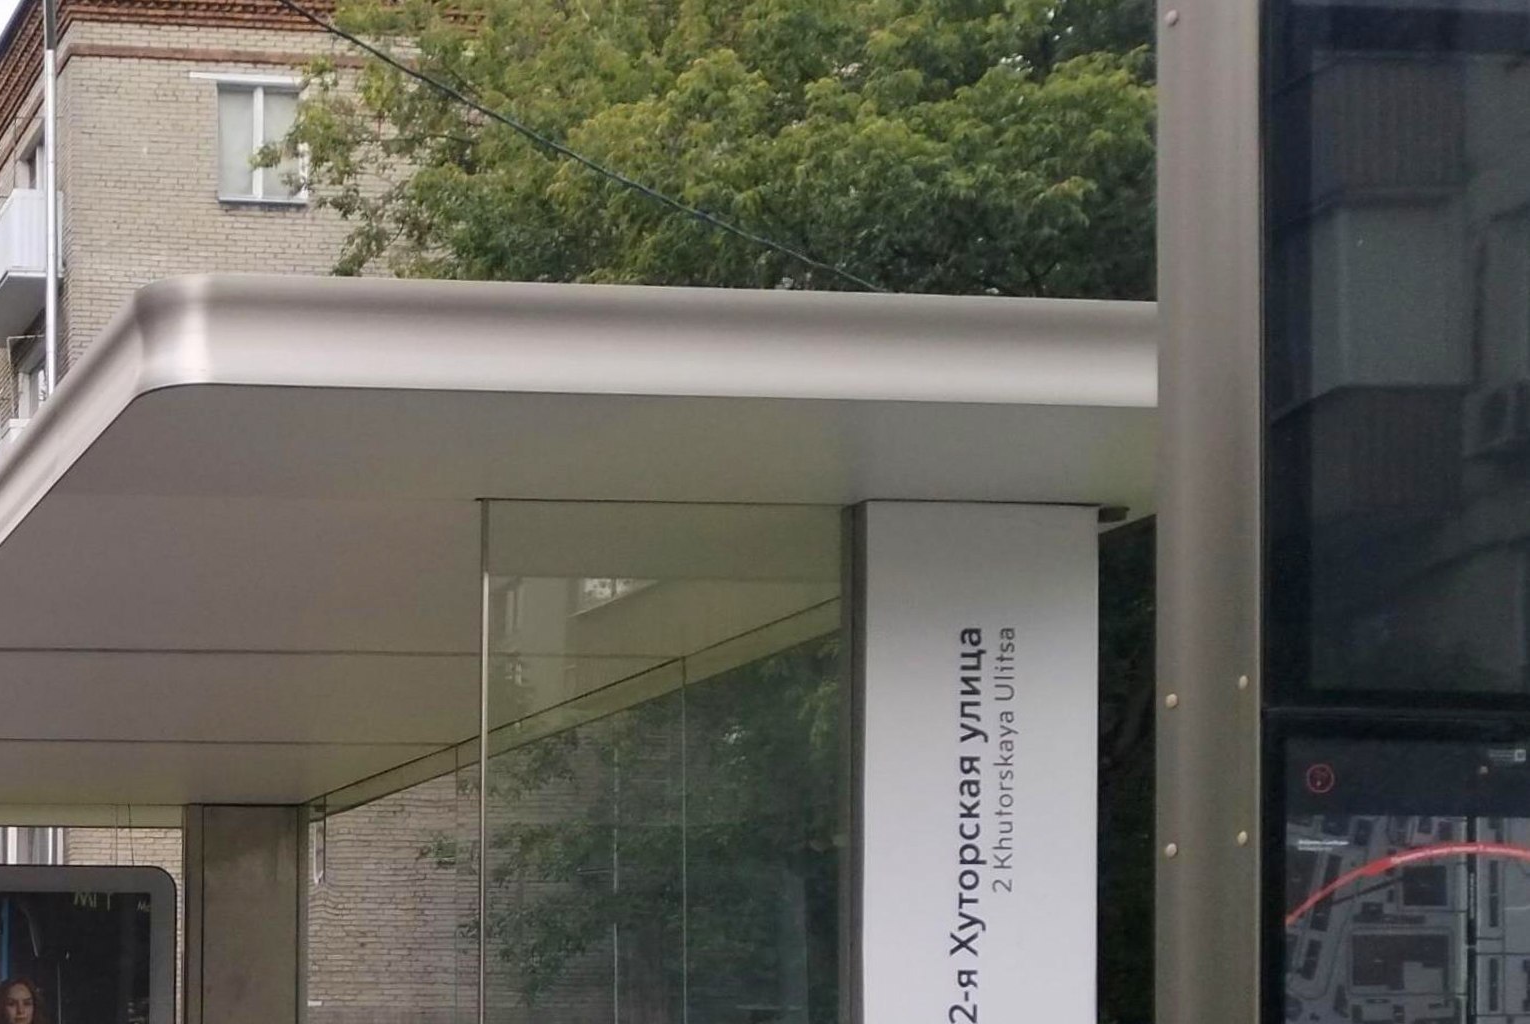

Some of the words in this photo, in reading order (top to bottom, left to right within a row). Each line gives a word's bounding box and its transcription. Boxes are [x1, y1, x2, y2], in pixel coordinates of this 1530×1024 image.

[959, 627, 989, 743] улица
[993, 627, 1016, 701] Ulitsa
[992, 710, 1019, 870] Khutorskaya
[949, 755, 987, 957] Хуторская
[991, 879, 1013, 893] 2
[948, 968, 979, 1024] 2-я
